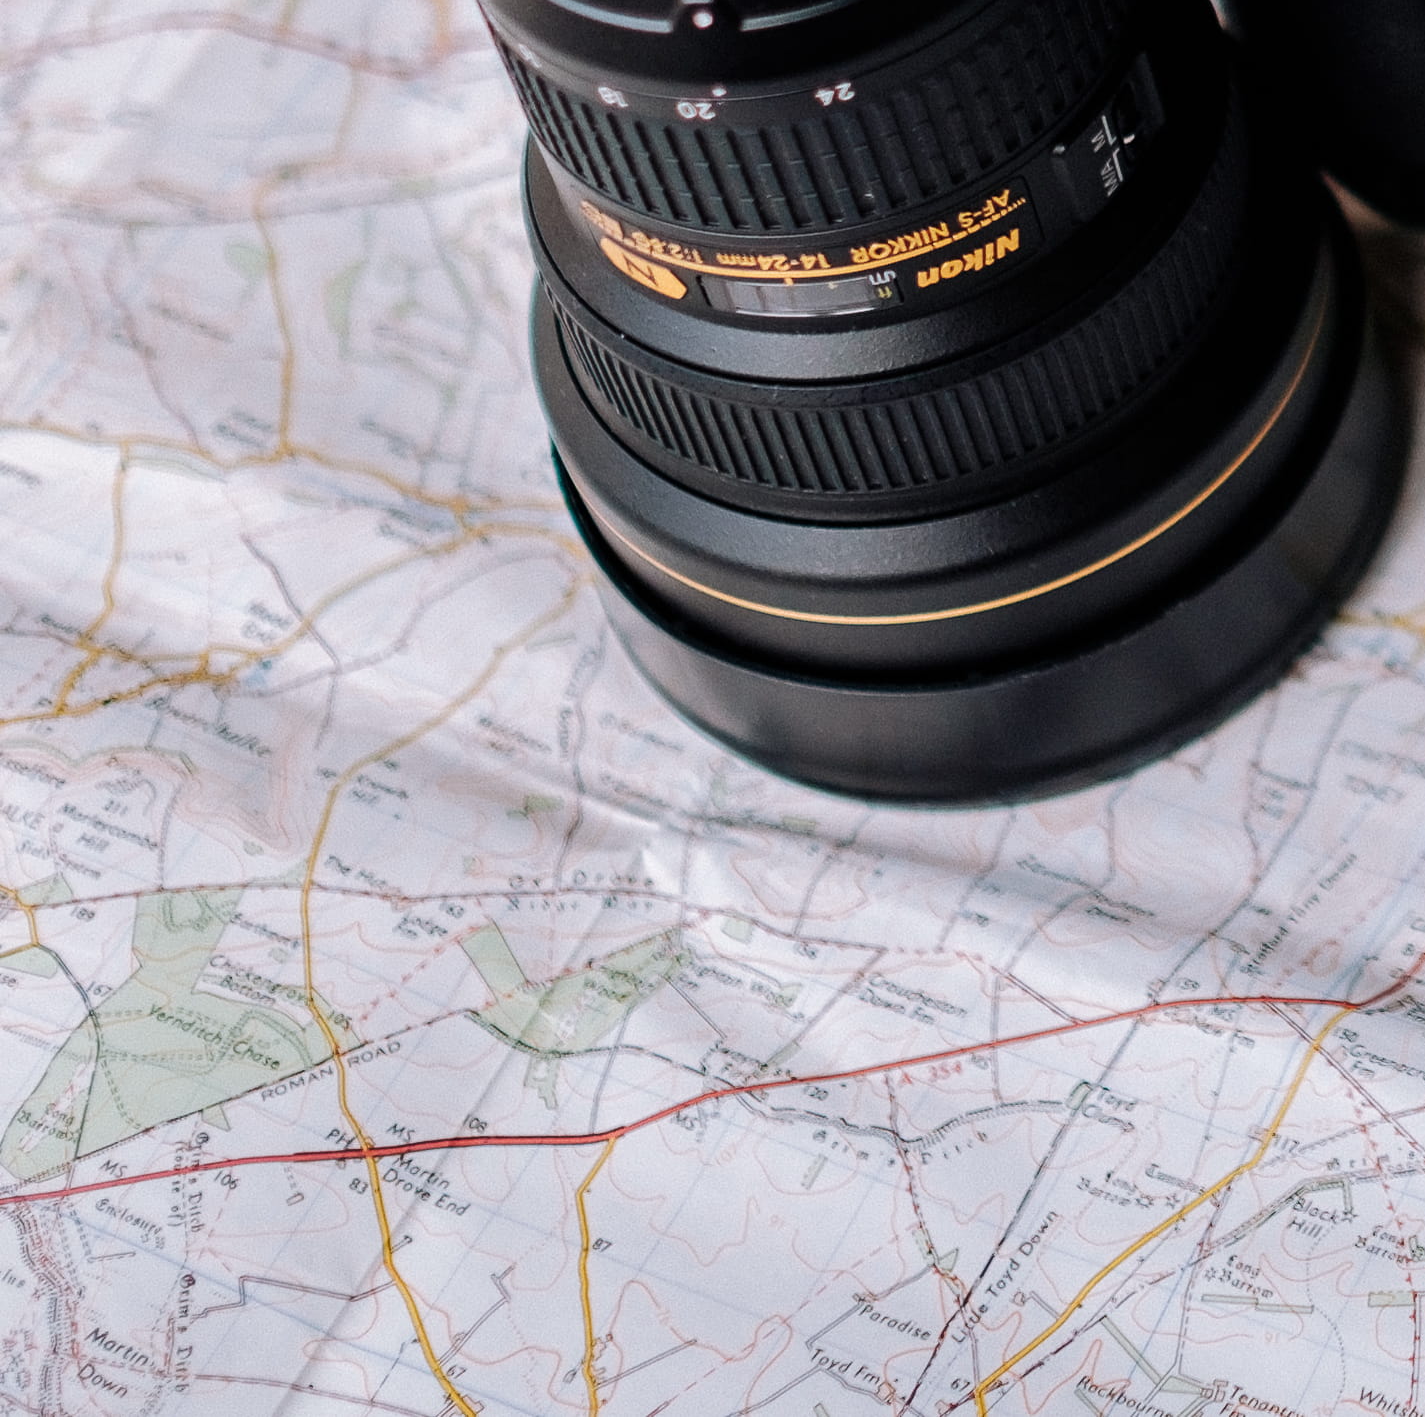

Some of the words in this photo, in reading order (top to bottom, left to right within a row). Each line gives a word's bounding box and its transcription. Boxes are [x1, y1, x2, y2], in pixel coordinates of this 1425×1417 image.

[677, 102, 717, 121] 20
[815, 82, 855, 107] 24
[958, 189, 1012, 229] AF-S
[850, 222, 950, 262] NIKKOR
[917, 228, 1020, 288] Nikon
[715, 252, 831, 272] 14-24mm
[233, 1041, 281, 1071] Chase
[260, 1064, 335, 1102] ROMAN
[346, 1040, 401, 1070] ROAD
[325, 1126, 353, 1152] PH
[388, 1122, 415, 1143] MS
[101, 1158, 127, 1180] MS
[392, 1153, 450, 1190] Martin
[382, 1167, 431, 1203] Drove
[435, 1192, 471, 1217] End
[1293, 1196, 1338, 1224] Black
[1021, 1210, 1059, 1257] Down
[1288, 1218, 1323, 1239] Hill
[857, 1303, 933, 1343] Paradise
[84, 1326, 150, 1367] Martin
[77, 1362, 129, 1400] Down
[445, 1364, 466, 1380] 67
[810, 1347, 852, 1378] Toyd
[853, 1362, 882, 1384] Fm
